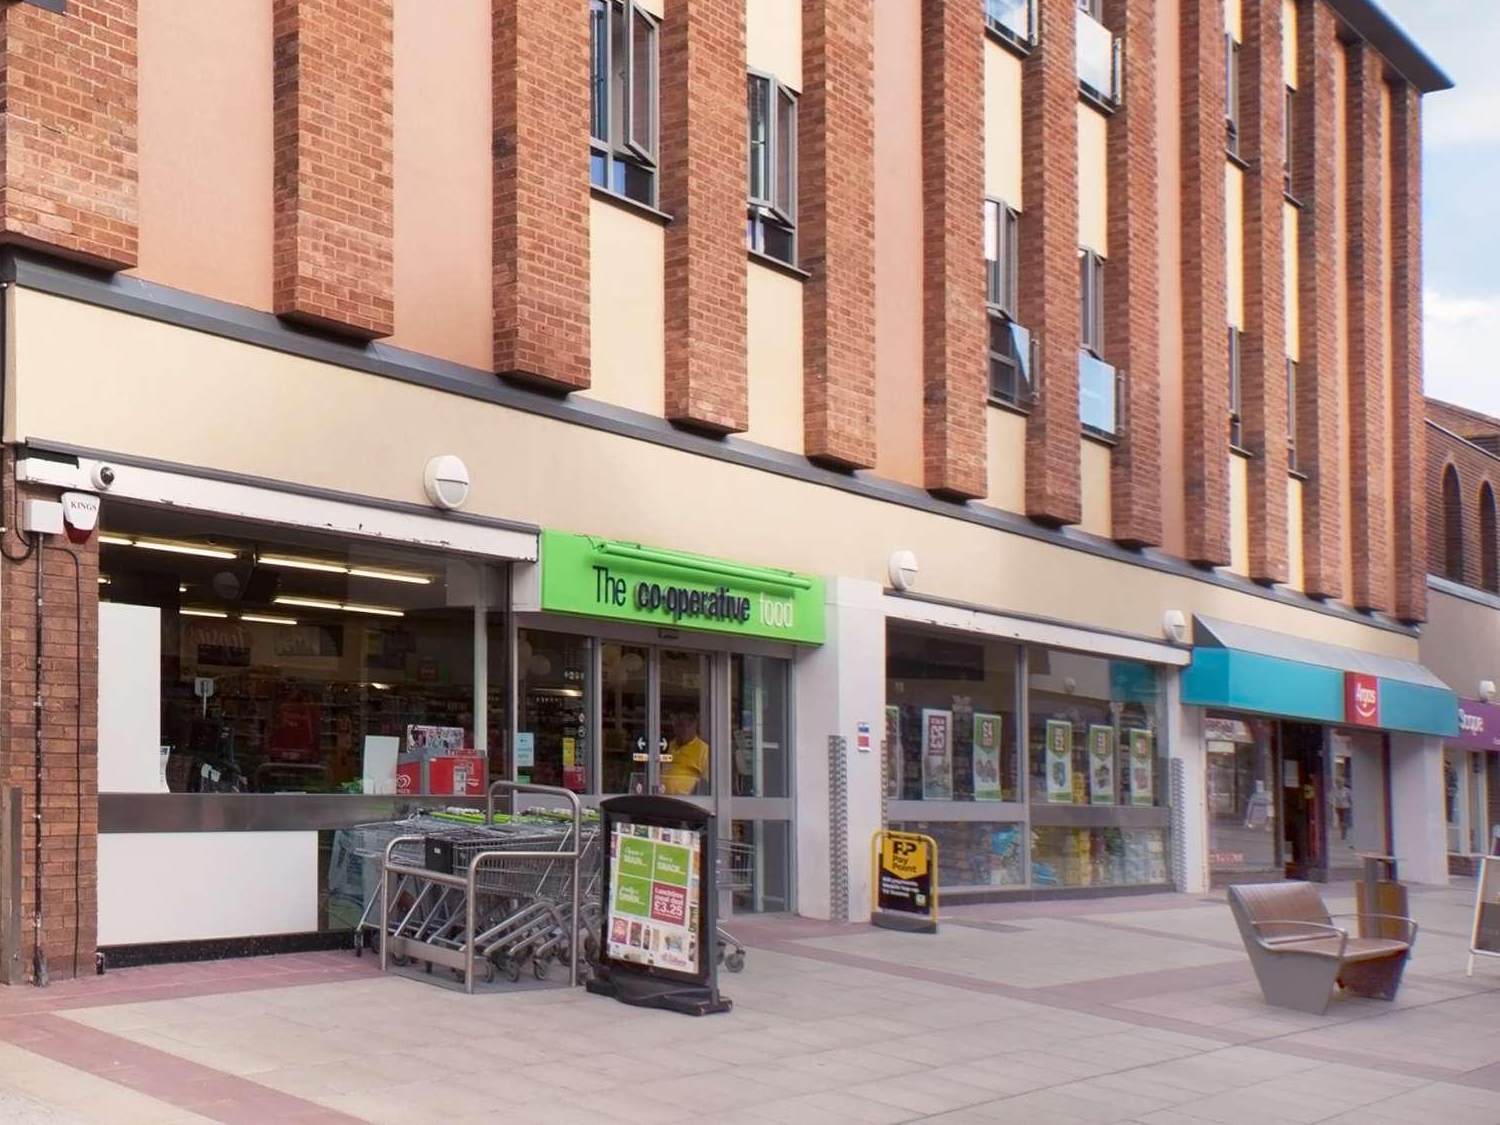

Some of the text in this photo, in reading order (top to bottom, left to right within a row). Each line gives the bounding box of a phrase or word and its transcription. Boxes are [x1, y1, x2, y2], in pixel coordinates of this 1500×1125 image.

[70, 501, 98, 511] KINGS
[592, 565, 627, 606] The
[758, 591, 795, 628] food
[1356, 682, 1376, 708] Argos
[1458, 708, 1485, 736] Scope
[892, 855, 909, 866] Pay
[892, 863, 917, 873] Point
[654, 901, 684, 916] £3.25
